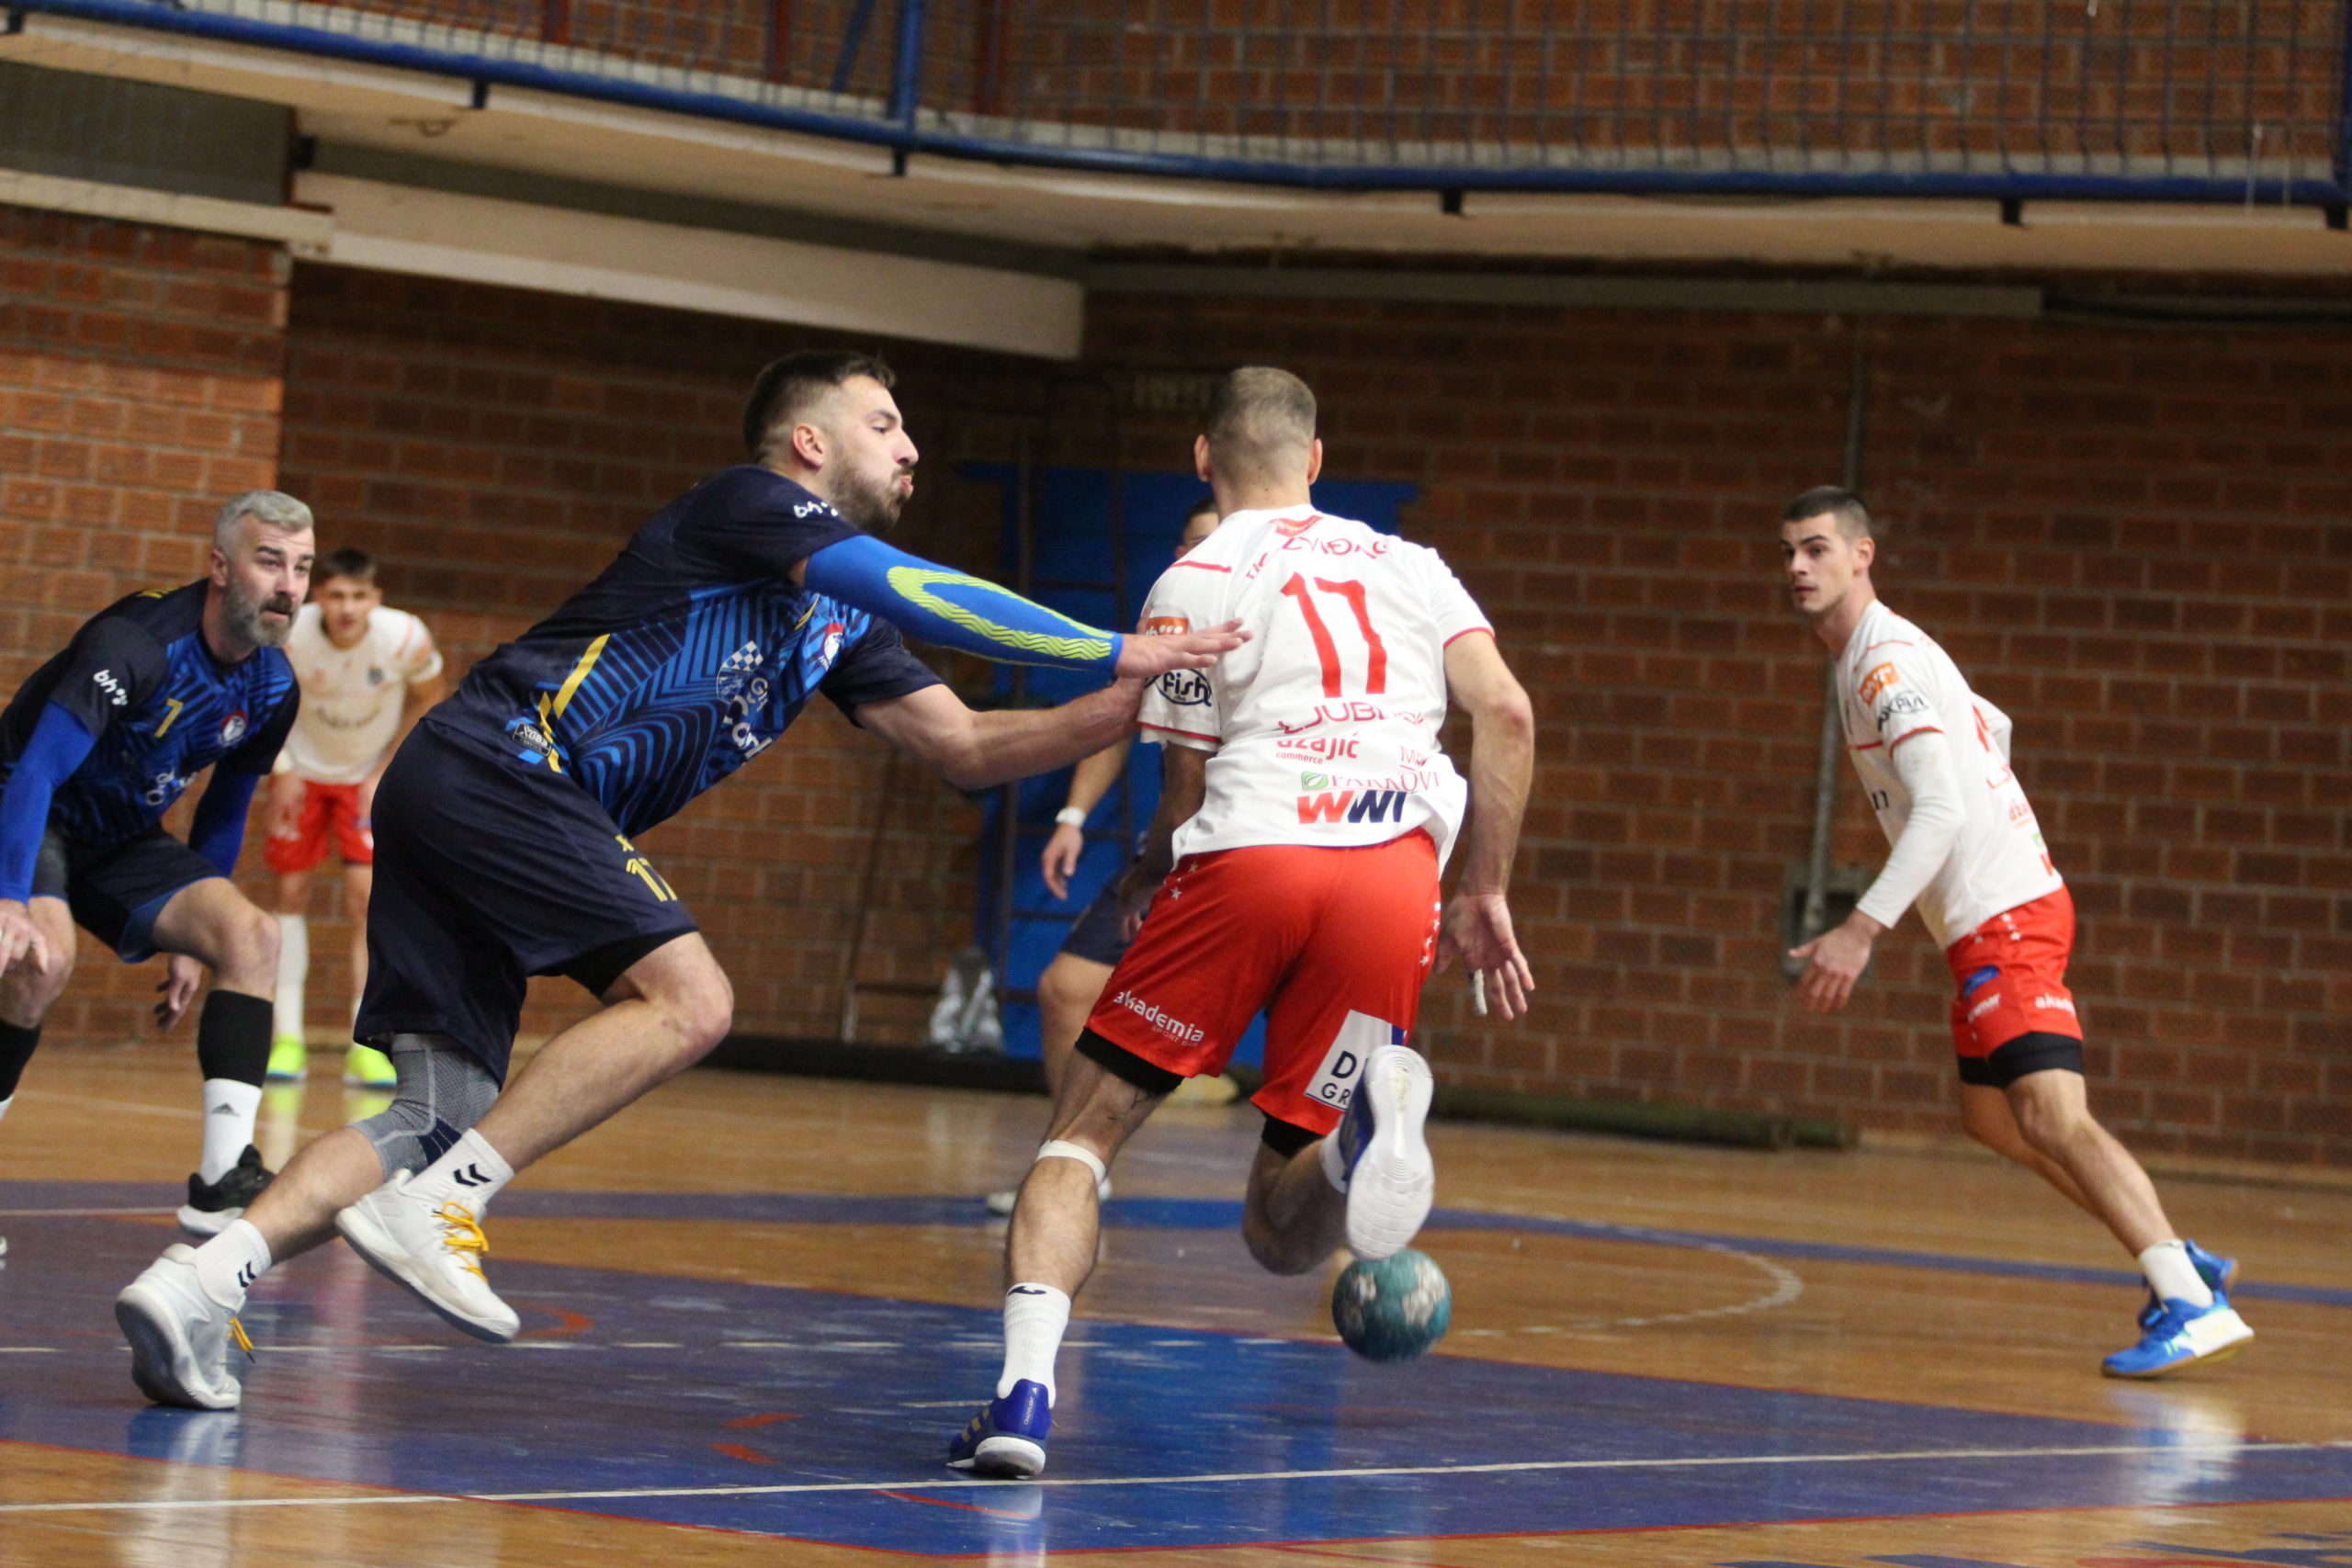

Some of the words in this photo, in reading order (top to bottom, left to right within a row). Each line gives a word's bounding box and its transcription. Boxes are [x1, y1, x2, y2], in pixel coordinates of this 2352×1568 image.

[1280, 571, 1387, 699] 17
[1163, 671, 1212, 706] fish
[1276, 751, 1324, 765] commerce
[1114, 990, 1204, 1043] akademia
